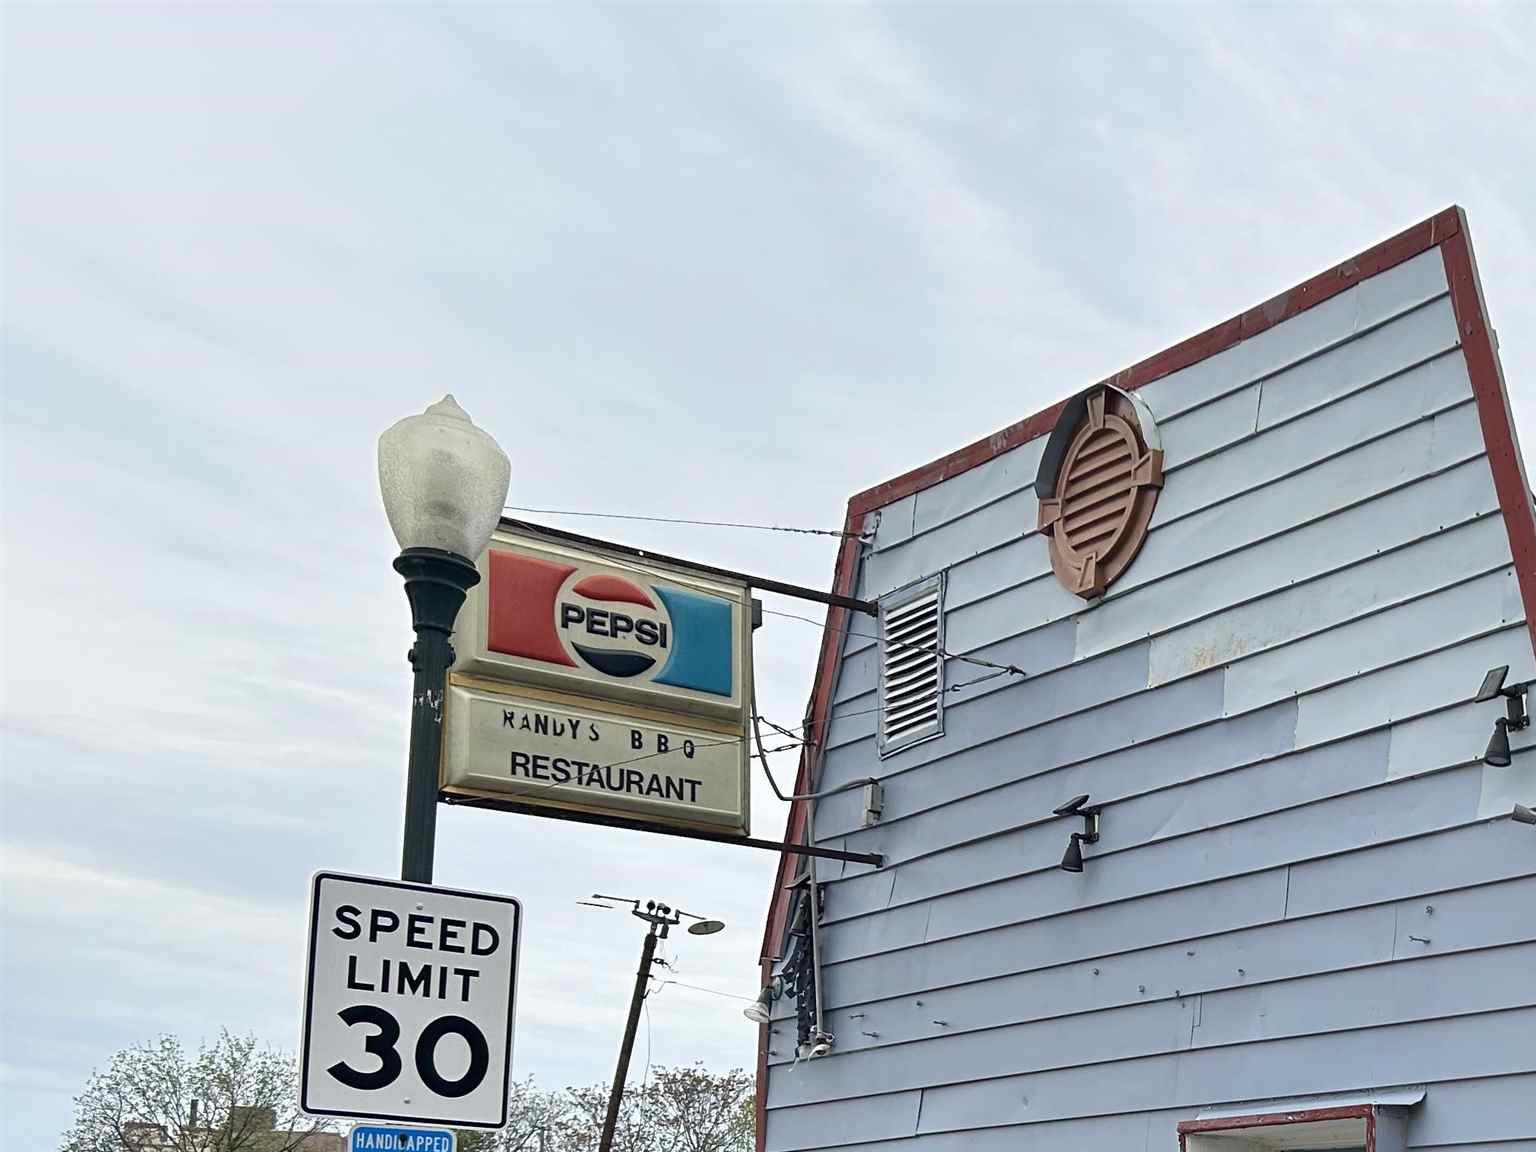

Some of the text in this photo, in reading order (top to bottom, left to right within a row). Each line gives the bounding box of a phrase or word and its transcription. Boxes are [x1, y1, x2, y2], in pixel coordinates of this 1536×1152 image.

[561, 602, 667, 648] PEPSI
[511, 751, 703, 802] RESTAURANT
[332, 904, 500, 956] SPEED
[347, 955, 480, 1002] LIMIT
[326, 1004, 490, 1098] 30
